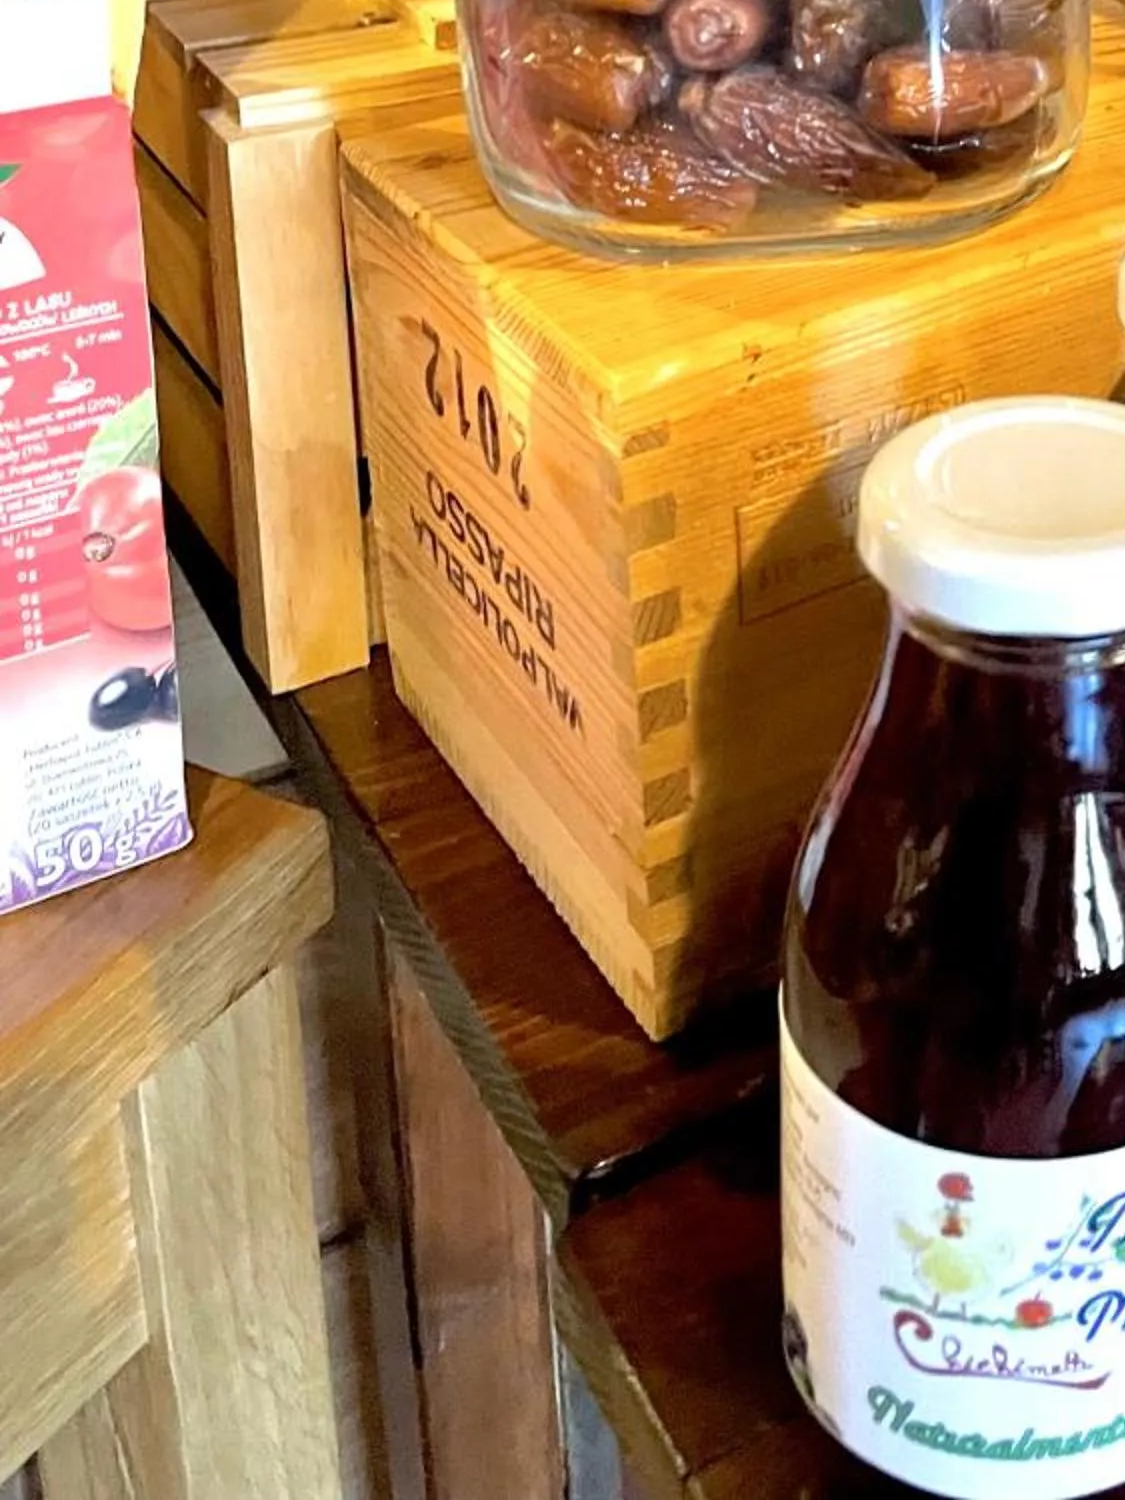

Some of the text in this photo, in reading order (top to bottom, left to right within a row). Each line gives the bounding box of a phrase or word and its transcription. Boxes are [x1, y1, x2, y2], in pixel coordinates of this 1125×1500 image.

[421, 316, 531, 511] 2012
[409, 503, 585, 741] VALPOLICELLA
[426, 470, 556, 651] RIPASSO
[36, 828, 102, 887] 50
